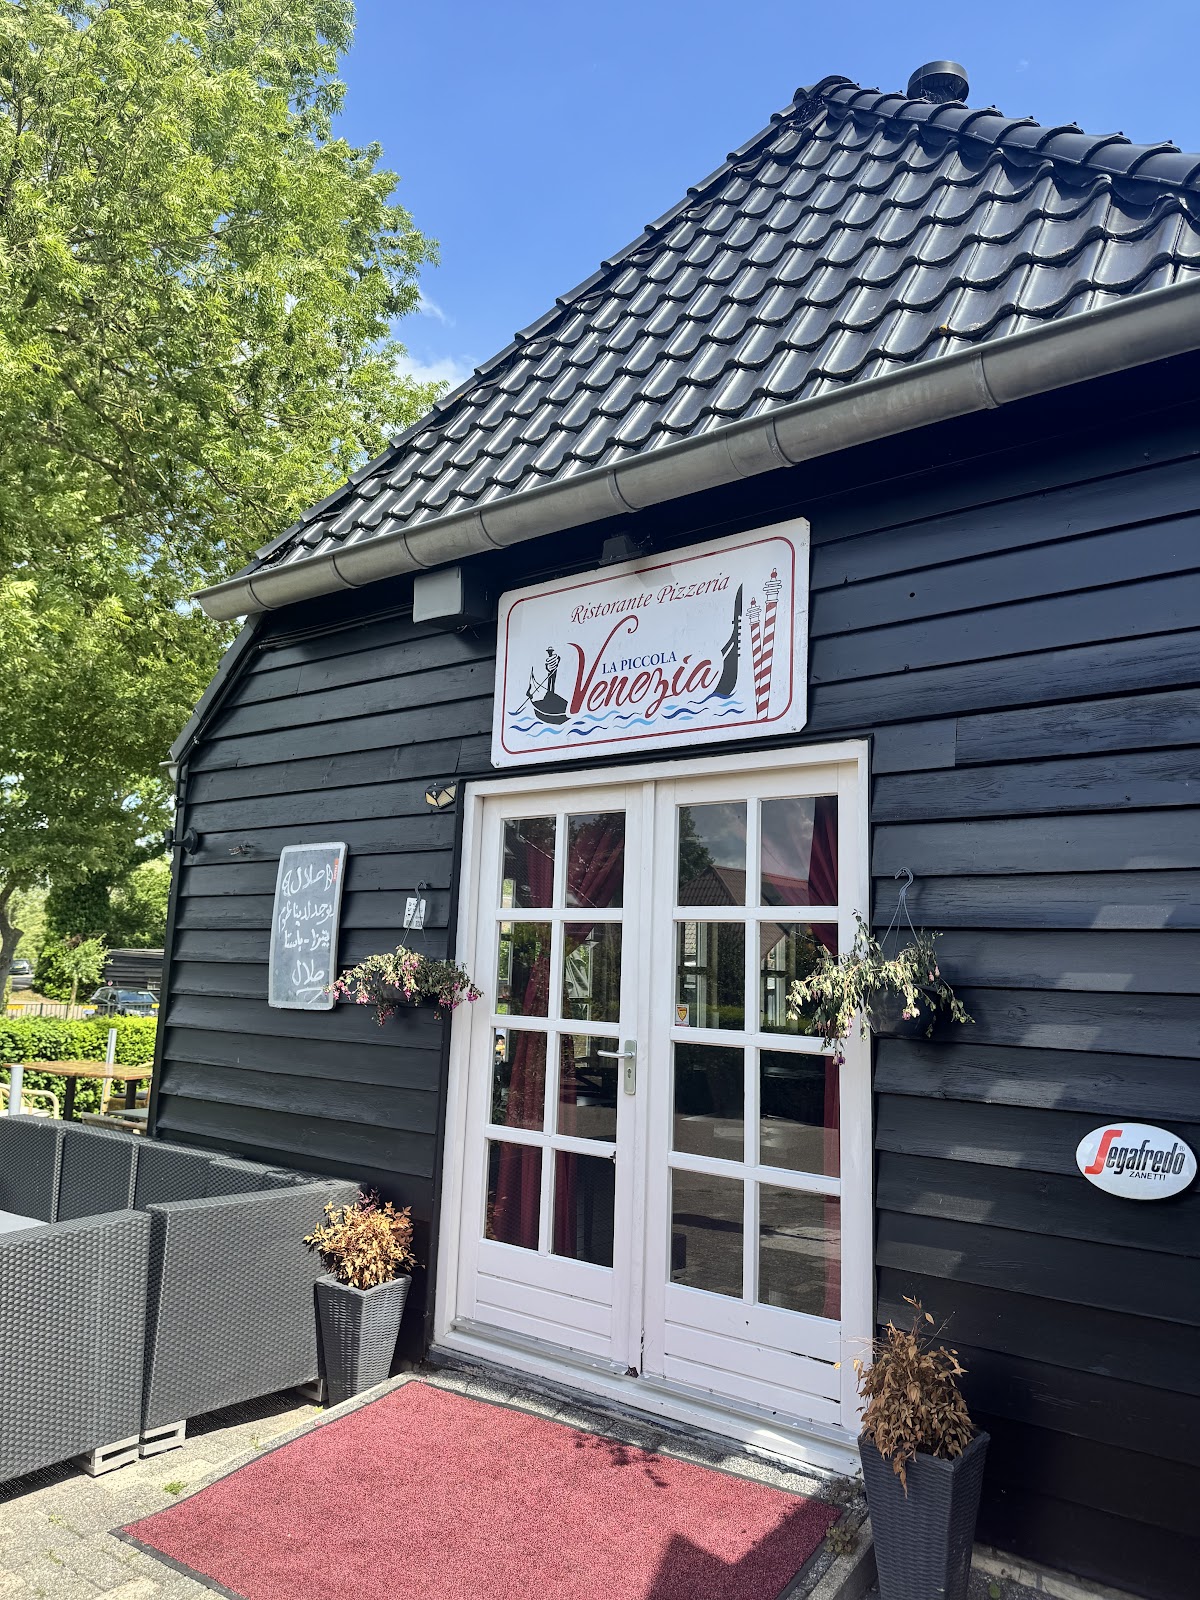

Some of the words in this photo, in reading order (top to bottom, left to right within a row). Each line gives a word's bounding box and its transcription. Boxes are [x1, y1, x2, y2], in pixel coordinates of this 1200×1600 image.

[571, 592, 652, 624] Ristorante
[657, 572, 731, 604] Pizzeria
[567, 614, 720, 719] Venezia
[602, 662, 618, 675] LA
[620, 650, 677, 673] PICCOLA
[291, 959, 325, 986] حلال
[1129, 1171, 1166, 1181] ZANETTI
